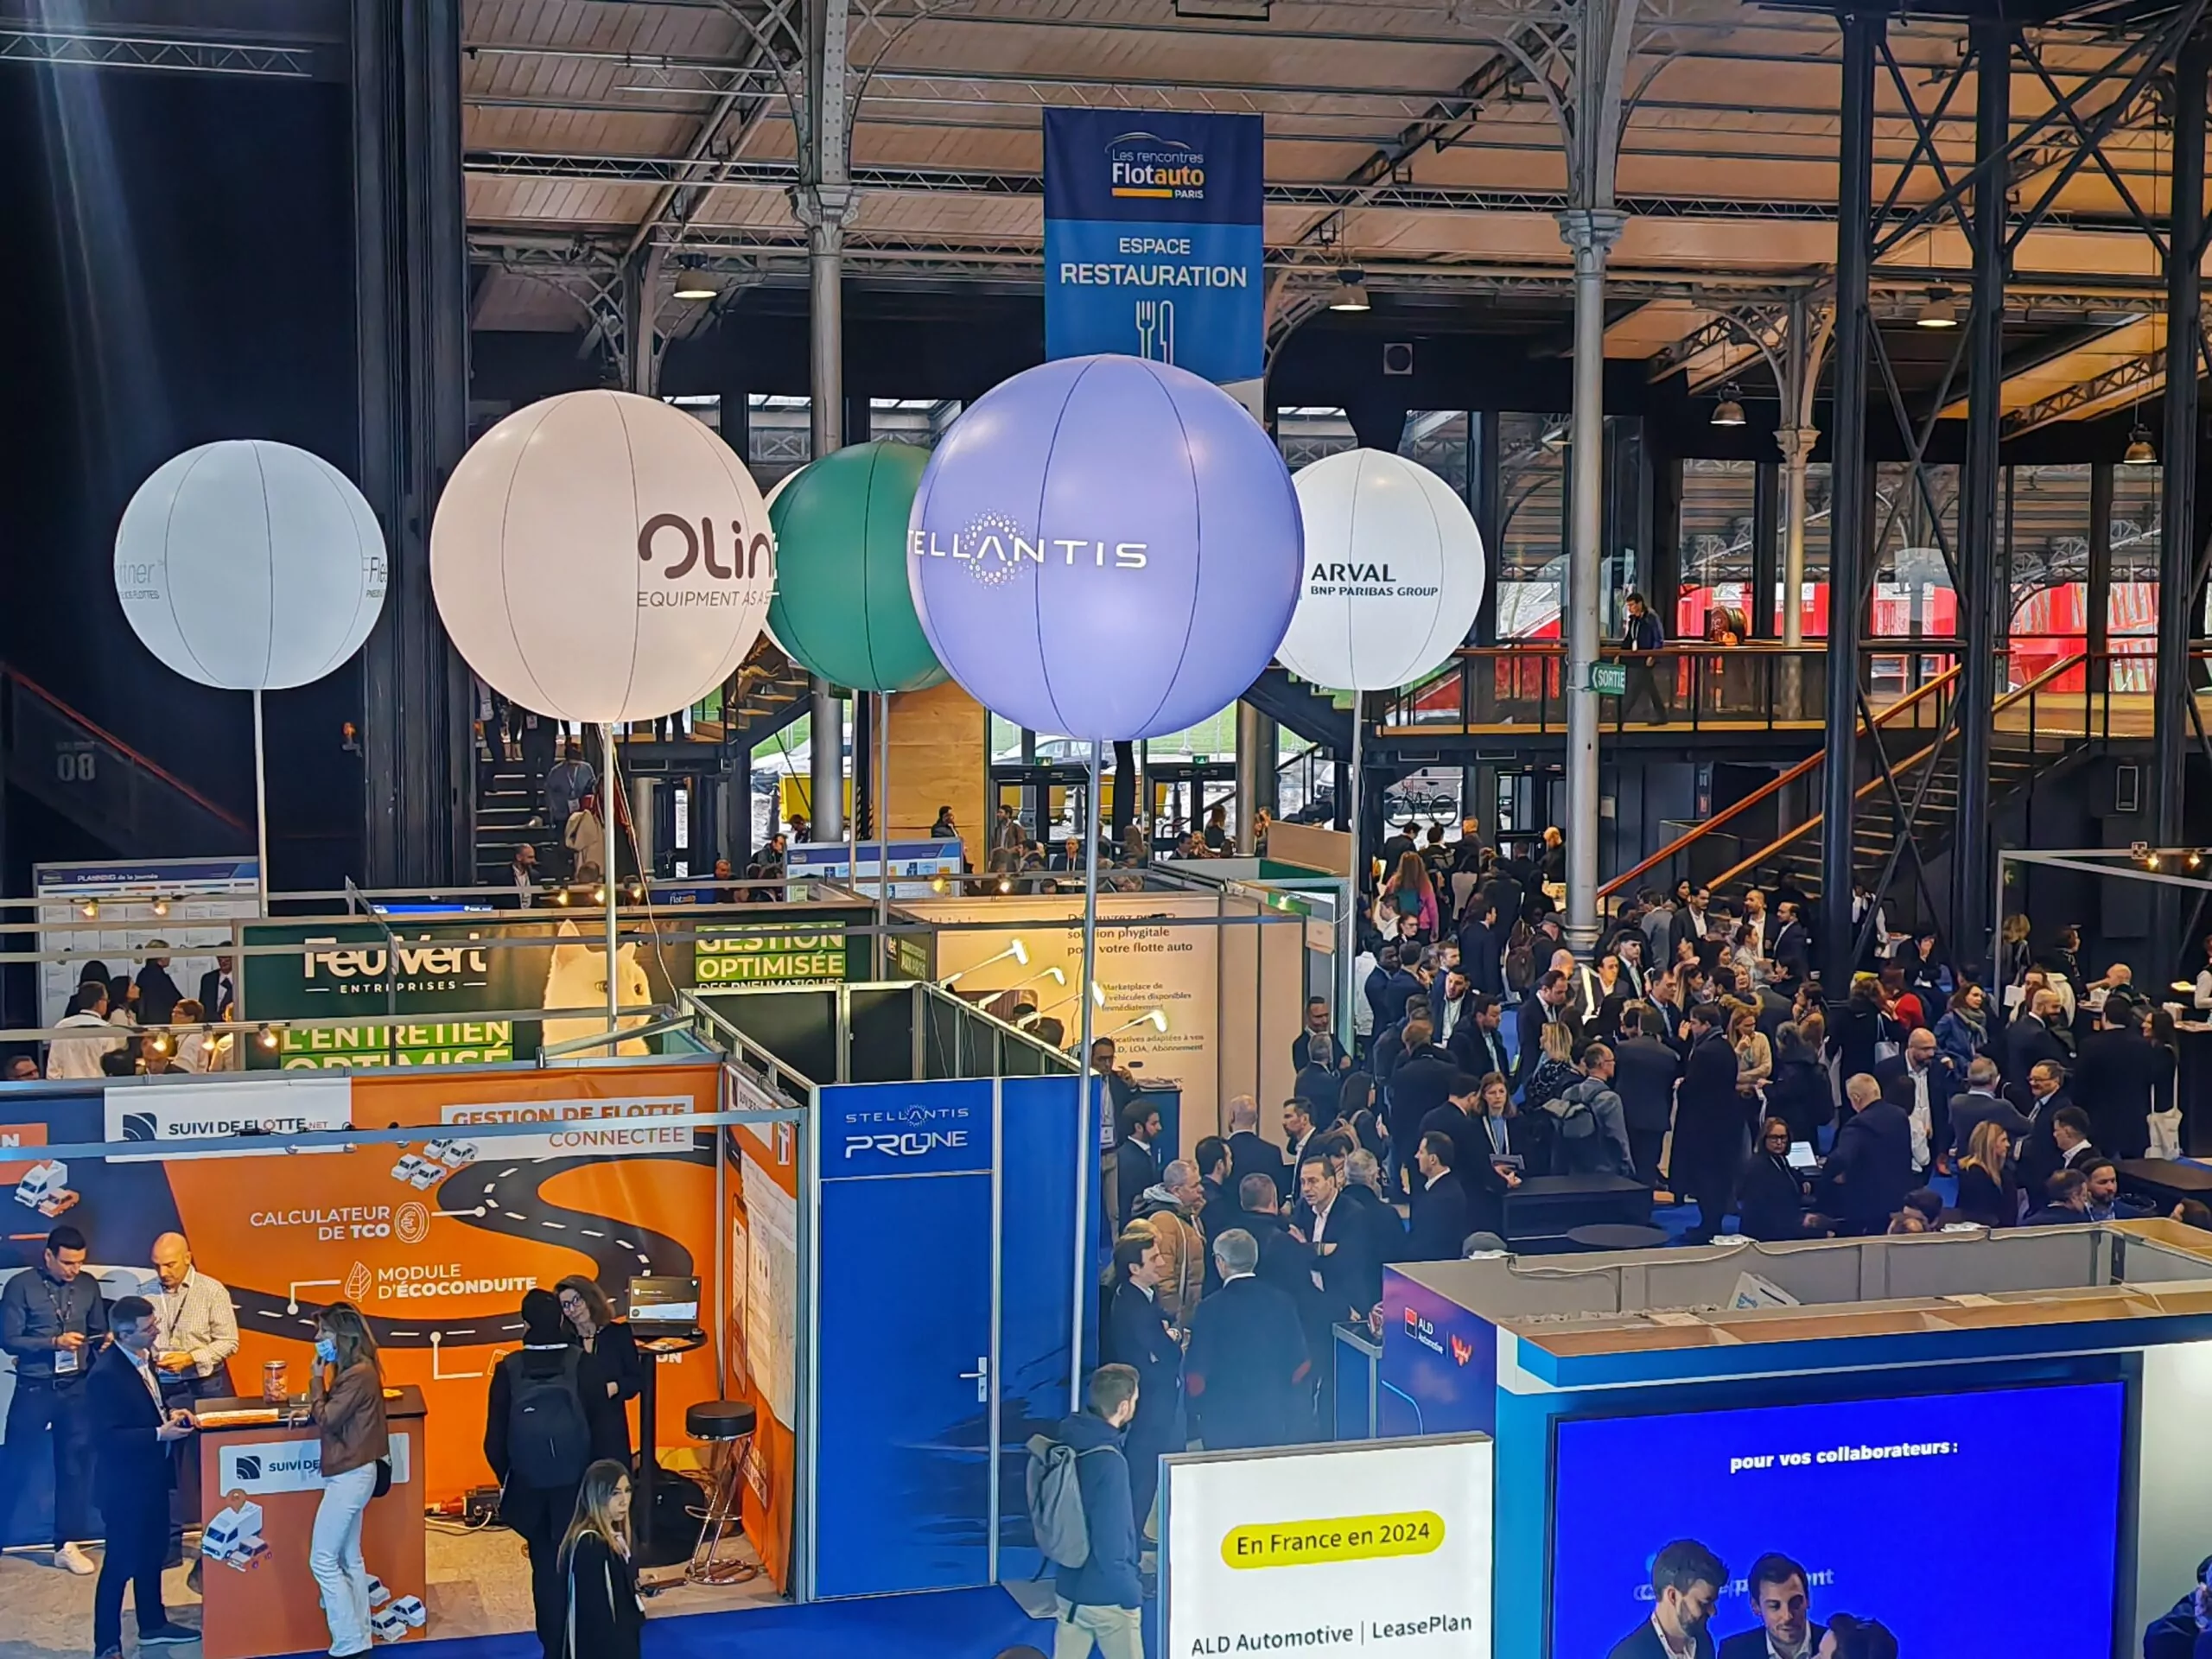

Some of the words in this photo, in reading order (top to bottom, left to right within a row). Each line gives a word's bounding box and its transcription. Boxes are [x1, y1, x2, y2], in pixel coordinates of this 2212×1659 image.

[1112, 148, 1134, 162] Les
[1137, 149, 1204, 164] rencontres
[1112, 162, 1205, 186] Flotauto
[1174, 188, 1204, 199] PARIS
[1119, 238, 1191, 254] ESPACE
[1060, 263, 1247, 287] RESTAURATION
[1311, 563, 1396, 582] ARVAL
[637, 591, 740, 607] EQUIPMENT
[1311, 586, 1336, 595] BNP
[1339, 587, 1394, 596] PARIBAS
[1397, 587, 1438, 597] GROUP
[1598, 669, 1624, 689] SORTIE
[1067, 927, 1114, 938] solion
[1118, 926, 1170, 940] phygitale
[1133, 942, 1164, 952] flotte
[1166, 943, 1193, 951] auto
[698, 950, 843, 979] OPTIMISÉE
[1147, 991, 1192, 1001] disponibles
[1152, 1044, 1204, 1052] Abonnement
[845, 1108, 969, 1123] STELLANTIS
[168, 1122, 213, 1135] SUIVI
[218, 1121, 239, 1133] DE
[250, 1206, 390, 1227] CALCULATEUR
[318, 1226, 346, 1241] DE
[350, 1224, 390, 1238] TCO
[378, 1264, 461, 1281] MODULE
[378, 1276, 538, 1300] D'ÉCOCONDUITE
[1418, 1318, 1433, 1335] ALD
[269, 1460, 302, 1472] SUIVI
[1730, 1456, 1774, 1474] pour
[1779, 1452, 1811, 1465] vos
[1816, 1441, 1950, 1463] collaborateurs
[1237, 1536, 1262, 1555] En
[1270, 1529, 1341, 1554] France
[1348, 1529, 1373, 1546] en
[1379, 1522, 1430, 1543] 2024
[1192, 1637, 1230, 1656] ALD
[1236, 1624, 1353, 1651] Automotive
[1372, 1614, 1471, 1639] LeasePlan
